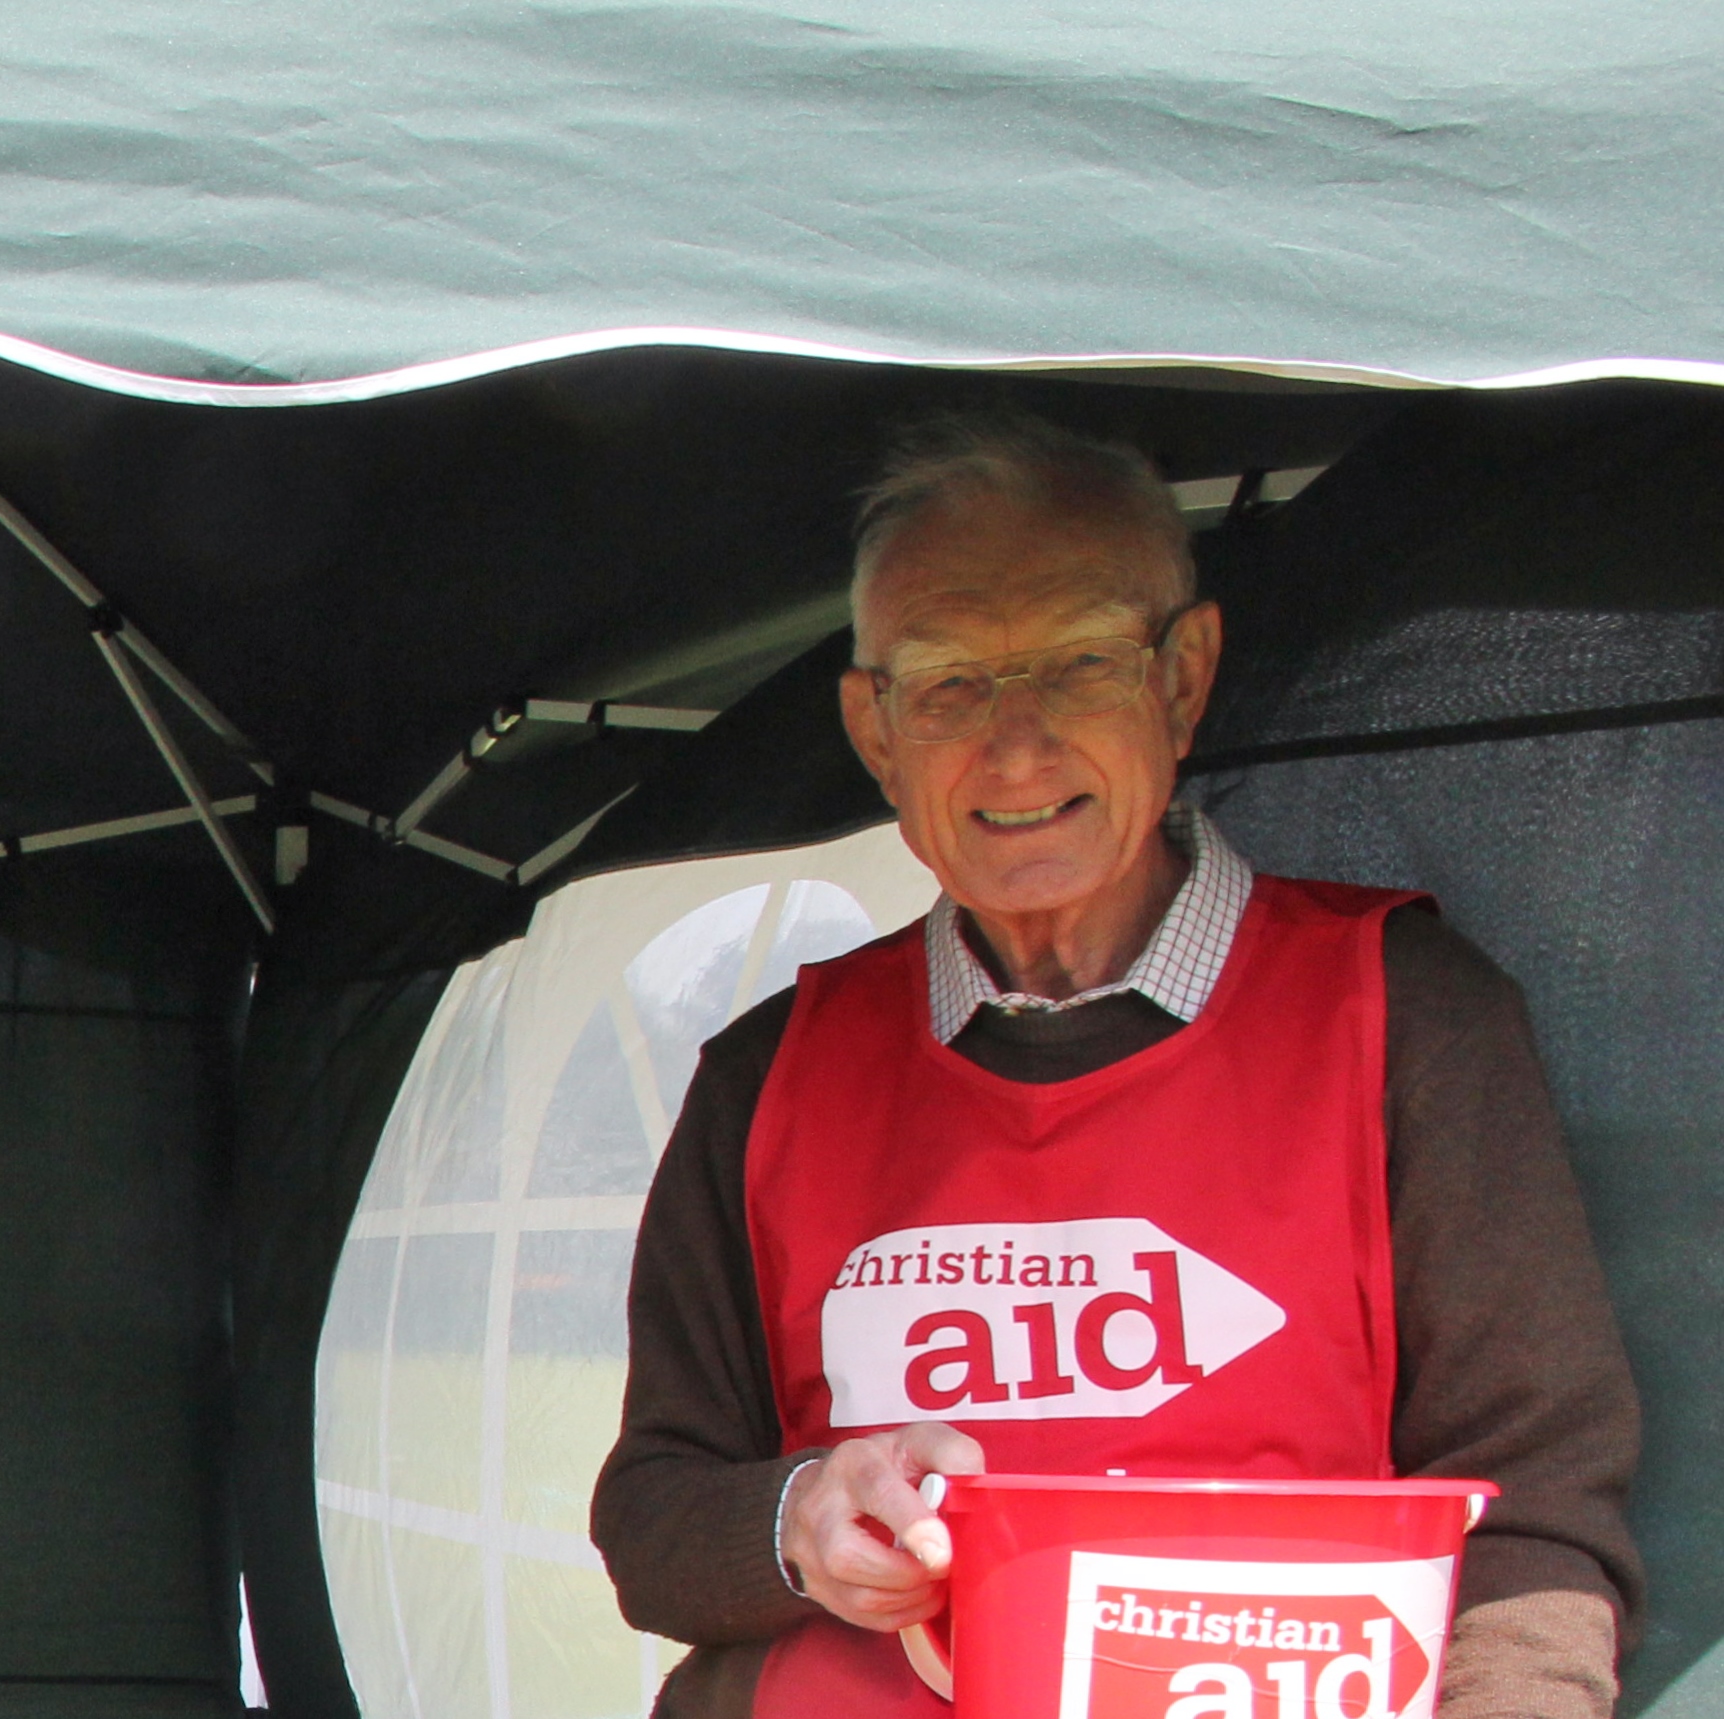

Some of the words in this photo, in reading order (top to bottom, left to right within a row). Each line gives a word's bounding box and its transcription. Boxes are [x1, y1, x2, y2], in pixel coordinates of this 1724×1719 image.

[829, 1240, 1099, 1290] christian
[903, 1250, 1205, 1412] aid
[1092, 1593, 1342, 1654] christian
